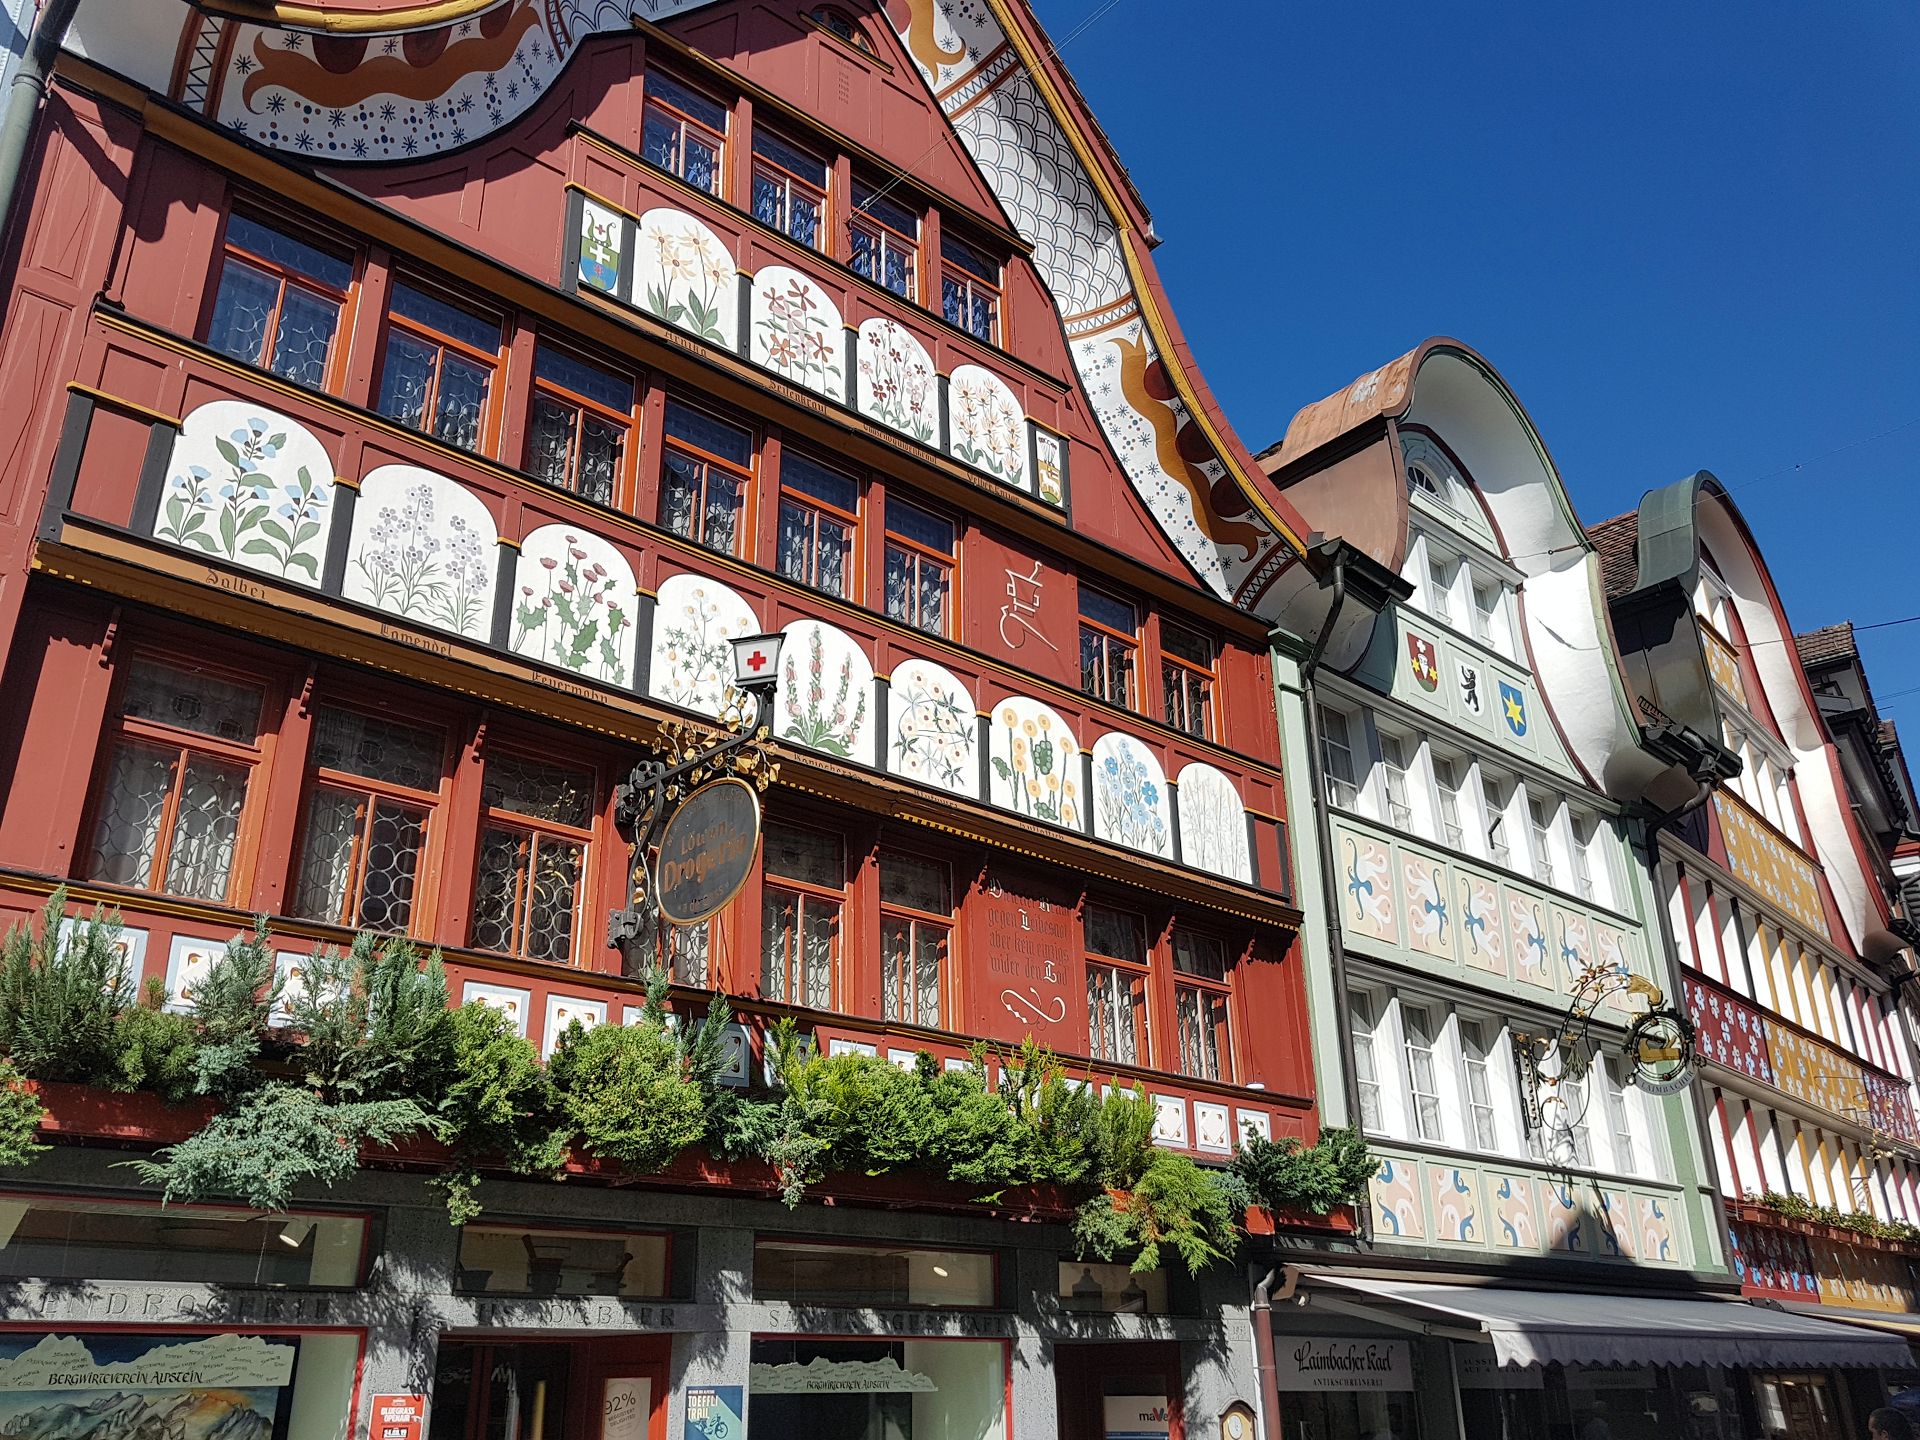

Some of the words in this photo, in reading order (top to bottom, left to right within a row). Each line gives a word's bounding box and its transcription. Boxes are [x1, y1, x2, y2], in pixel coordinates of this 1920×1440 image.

[988, 907, 1017, 931] gegen
[989, 930, 1011, 950] aber
[1014, 932, 1034, 956] kein
[989, 951, 1020, 977] wider
[1024, 957, 1041, 983] den
[1640, 1070, 1694, 1093] LAIMBACHER
[1293, 1340, 1365, 1374] Laimbacher
[1365, 1344, 1394, 1371] Karl
[604, 1390, 637, 1415] 92%
[687, 1395, 719, 1407] TOEFFLI
[687, 1407, 711, 1420] TRAIL
